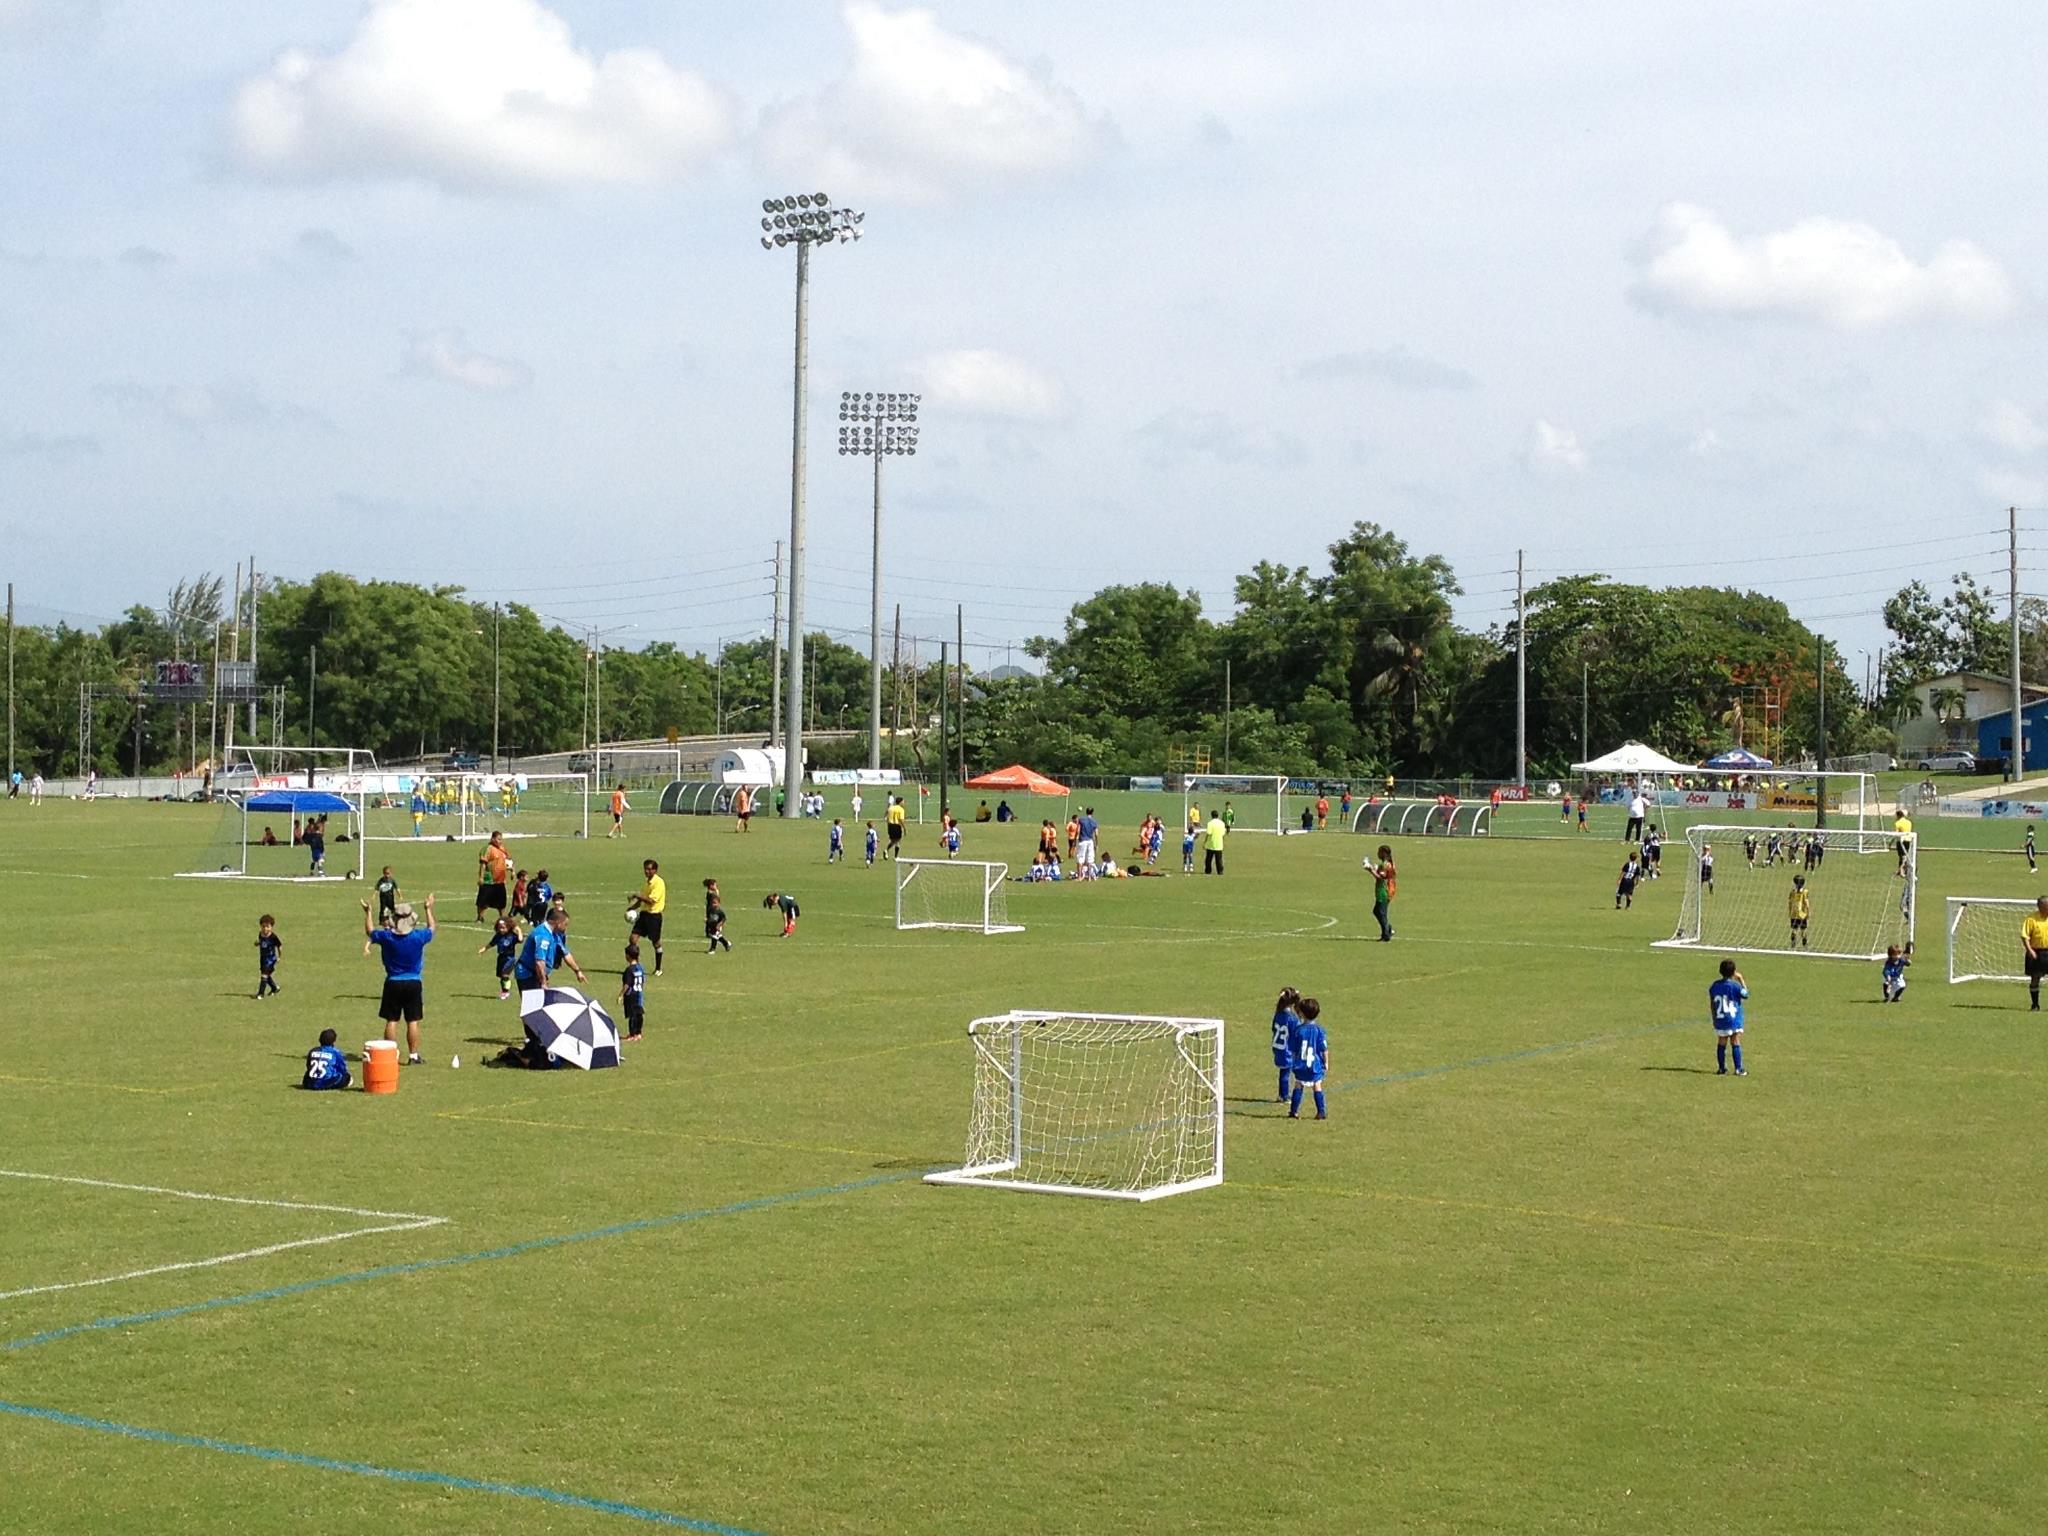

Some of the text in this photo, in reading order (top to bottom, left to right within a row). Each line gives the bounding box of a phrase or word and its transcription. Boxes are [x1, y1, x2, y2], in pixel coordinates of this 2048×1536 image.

[1714, 994, 1737, 1019] 24
[1272, 1022, 1289, 1050] 23
[309, 1059, 328, 1079] 25
